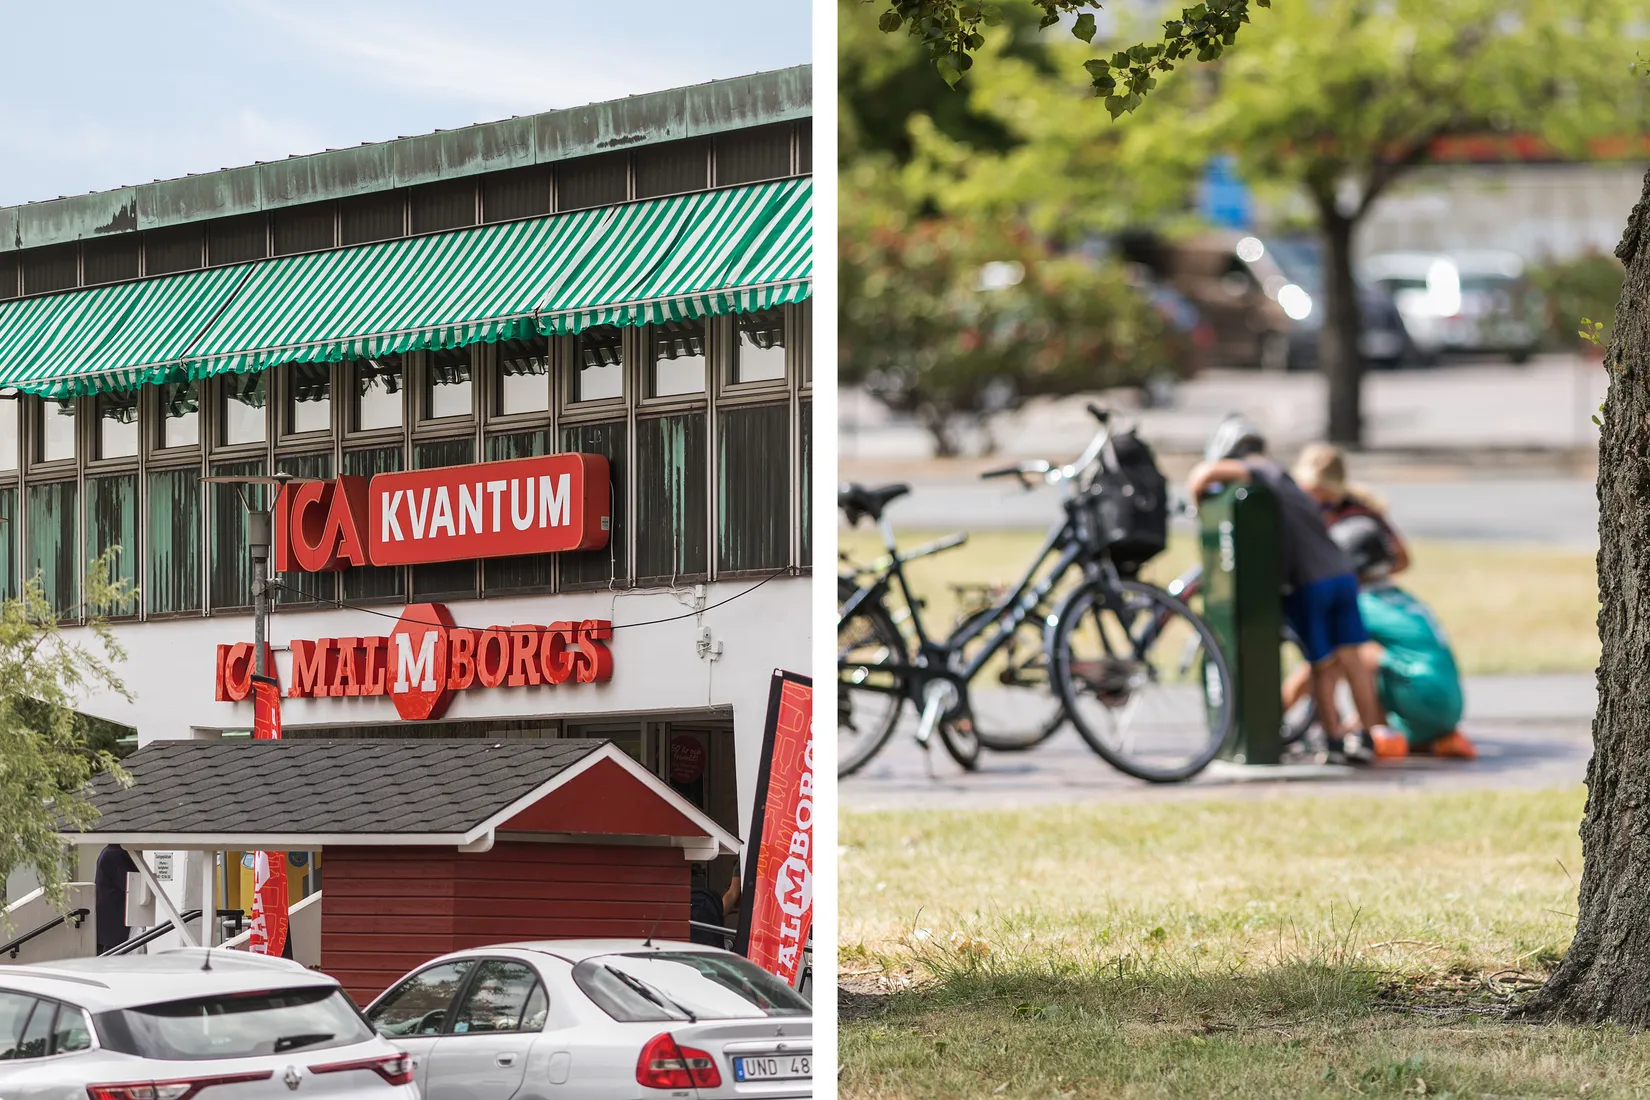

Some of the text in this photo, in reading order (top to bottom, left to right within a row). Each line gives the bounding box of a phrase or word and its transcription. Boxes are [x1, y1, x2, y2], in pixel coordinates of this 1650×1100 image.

[275, 473, 571, 572] ICA KVANTUM
[215, 618, 613, 702] IC MALMBORGS
[745, 1057, 811, 1076] UND 48
